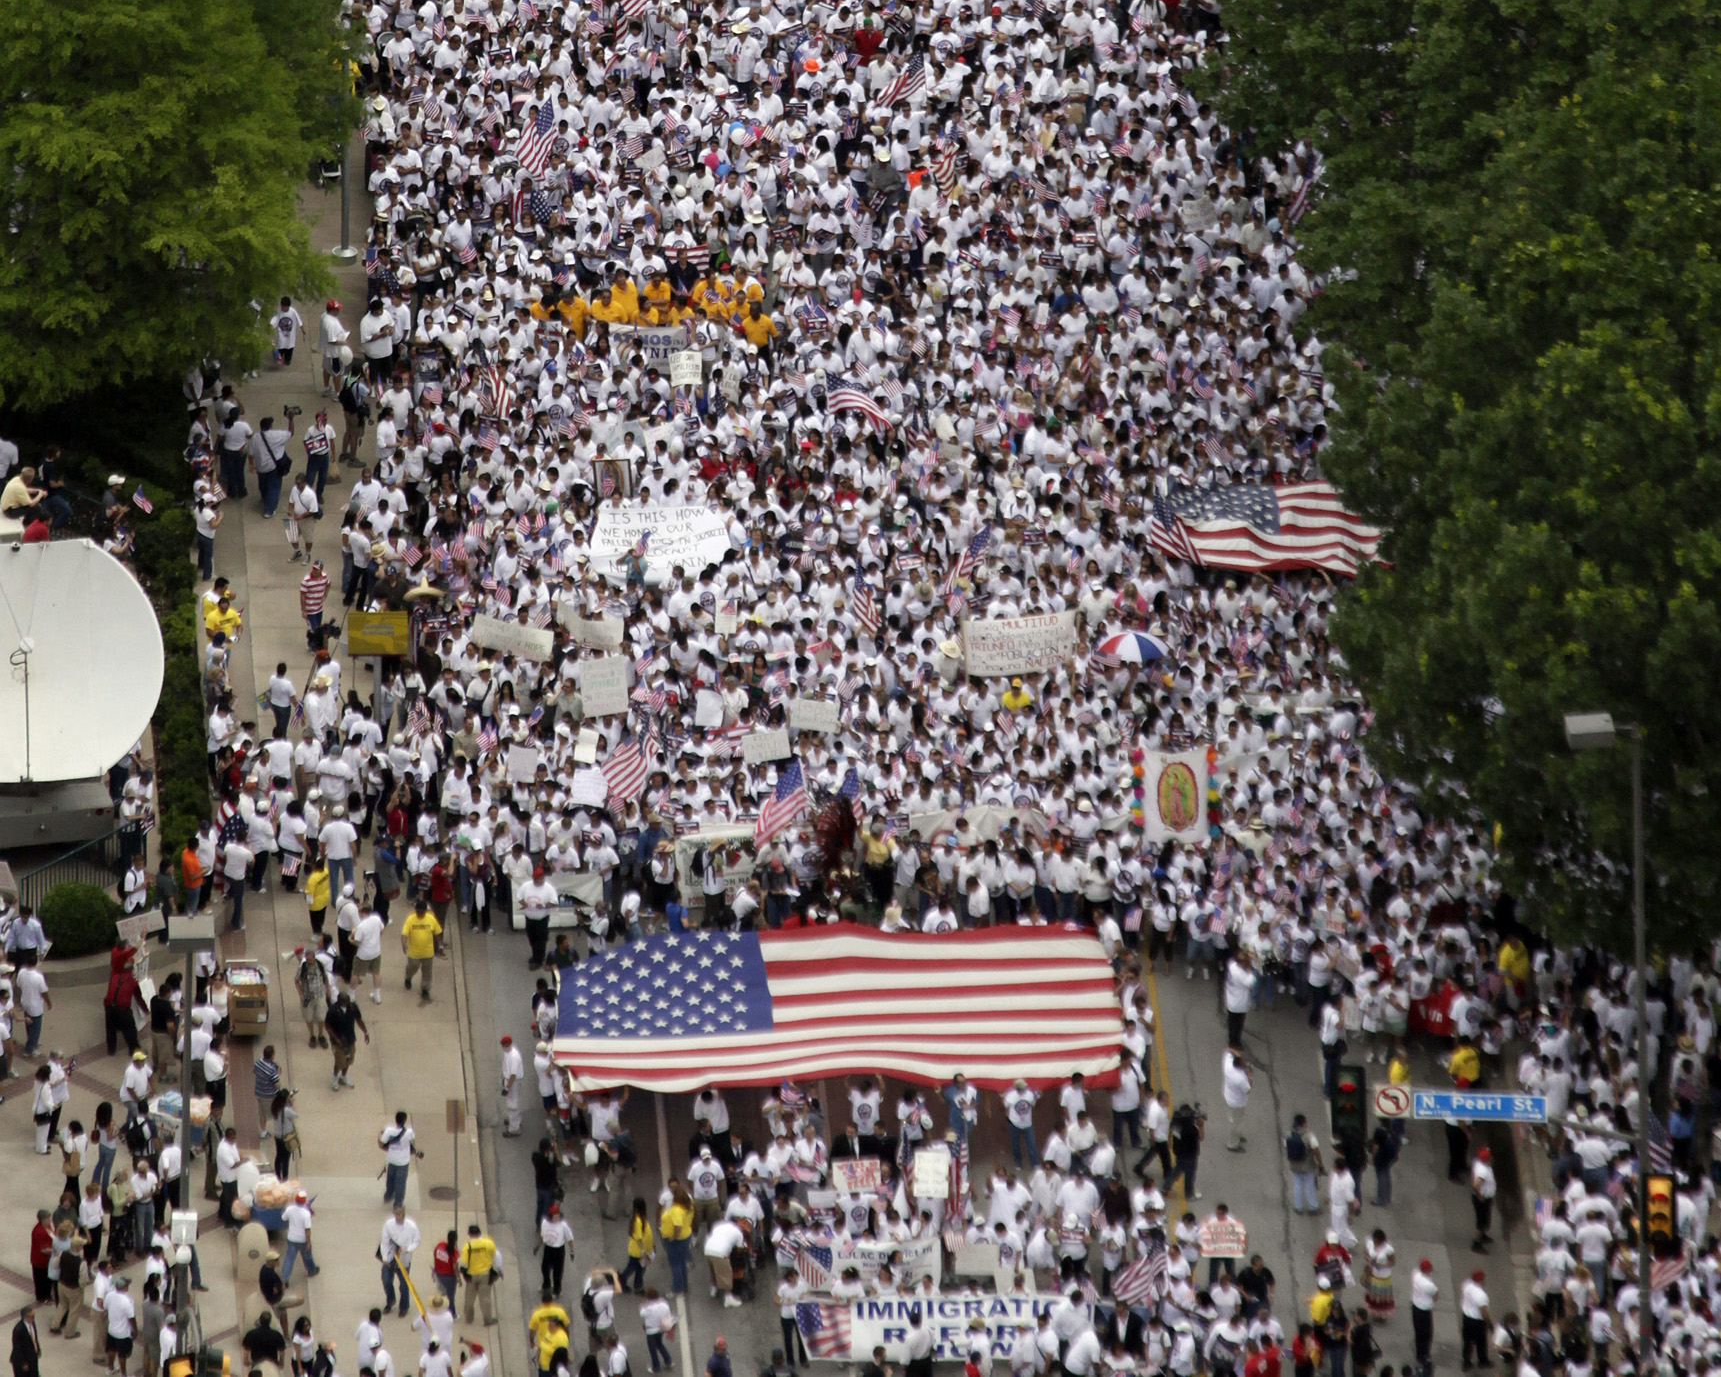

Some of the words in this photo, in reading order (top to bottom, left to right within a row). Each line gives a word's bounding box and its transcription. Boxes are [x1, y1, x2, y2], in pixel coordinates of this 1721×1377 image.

[608, 512, 631, 524] IS
[637, 510, 667, 523] THIS
[675, 507, 705, 521] HOW
[600, 527, 621, 538] WE
[666, 522, 694, 534] OUR
[601, 538, 633, 547] FALLEN
[666, 555, 708, 569] AGAIN
[1001, 615, 1059, 630] MULTITUD
[970, 640, 1015, 652] TRIUNFO
[1000, 646, 1060, 661] POBLACION
[1025, 655, 1066, 668] NACION
[1422, 1096, 1440, 1109] N.
[1452, 1097, 1501, 1110] Pearl
[1513, 1098, 1539, 1112] St.
